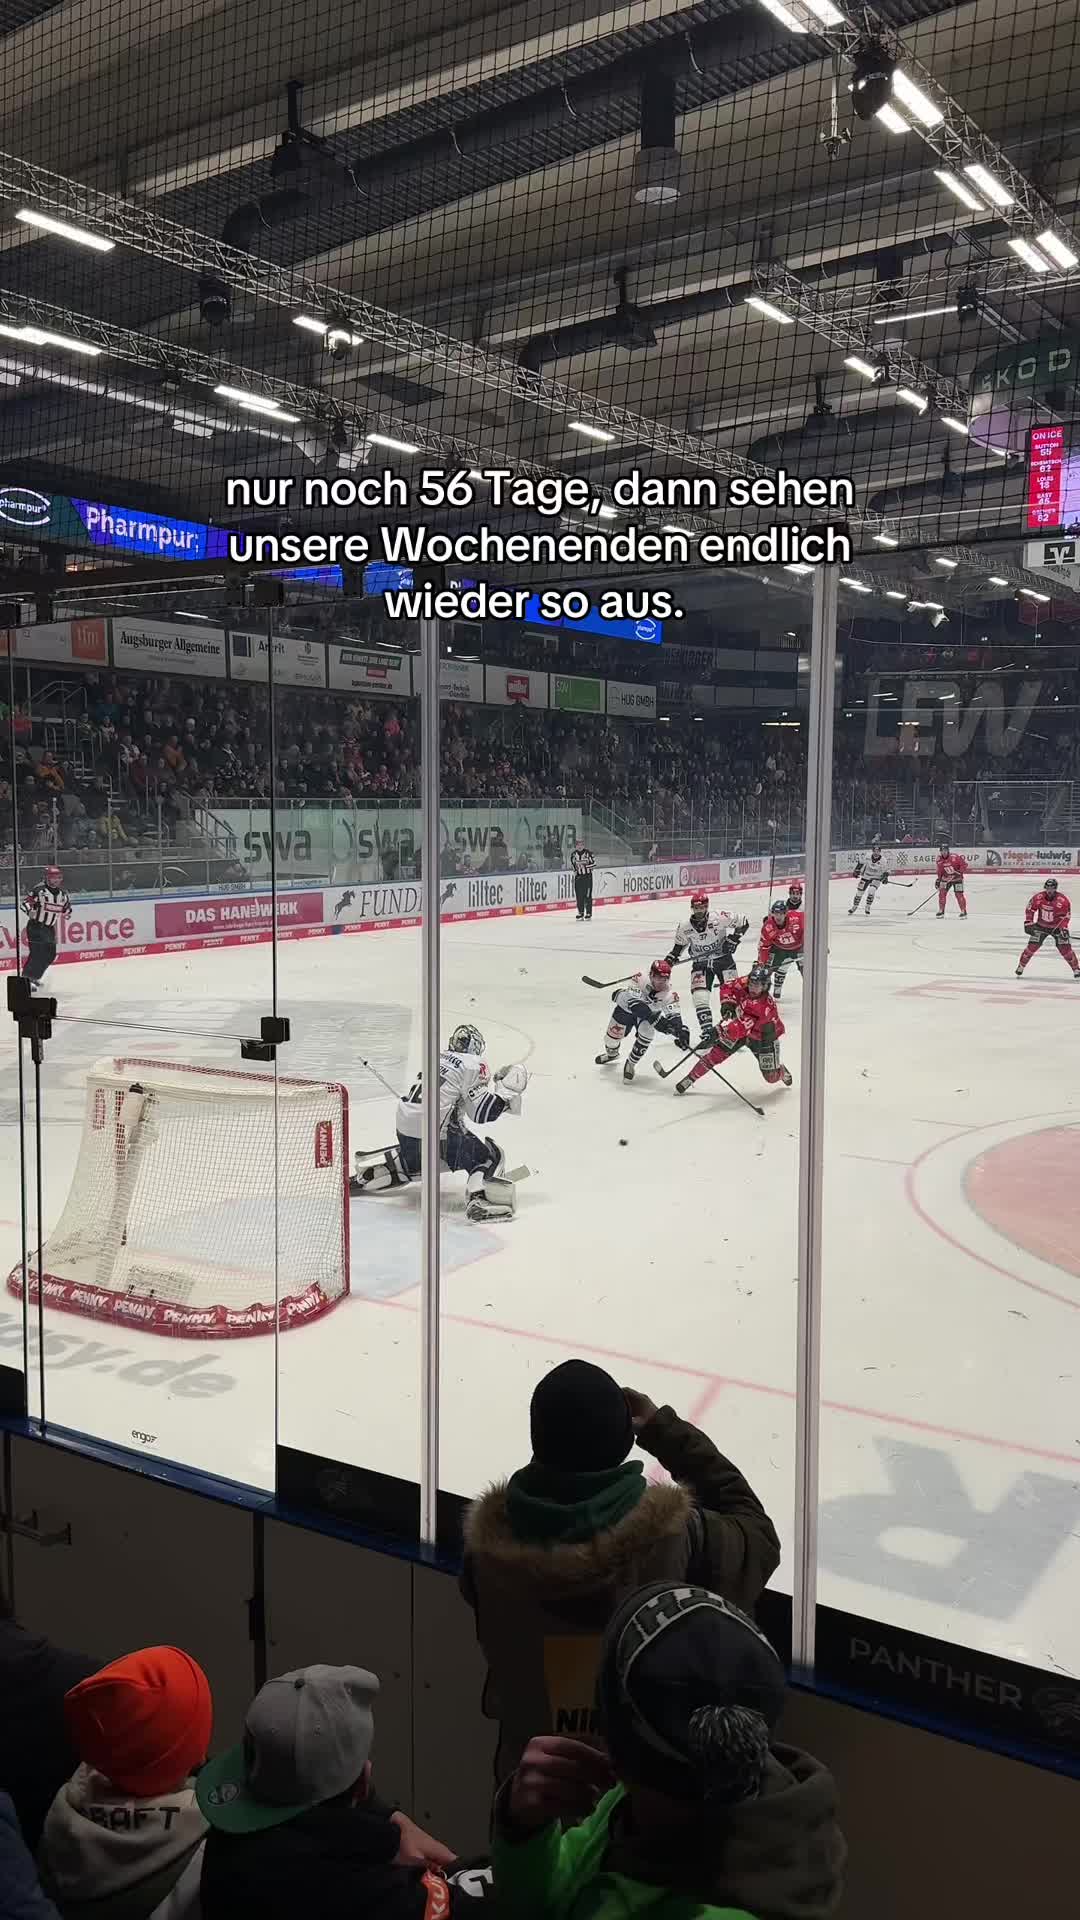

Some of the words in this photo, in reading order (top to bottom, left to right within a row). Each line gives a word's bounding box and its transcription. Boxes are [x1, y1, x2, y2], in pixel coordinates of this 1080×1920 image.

[1032, 432, 1046, 440] ON
[1047, 430, 1062, 439] ICE
[120, 630, 172, 649] Augsburger
[174, 637, 221, 655] Allgemeine
[244, 830, 312, 863] swa
[358, 828, 415, 859] swa
[185, 909, 216, 923] DAS
[849, 1637, 1024, 1712] PANTHER
